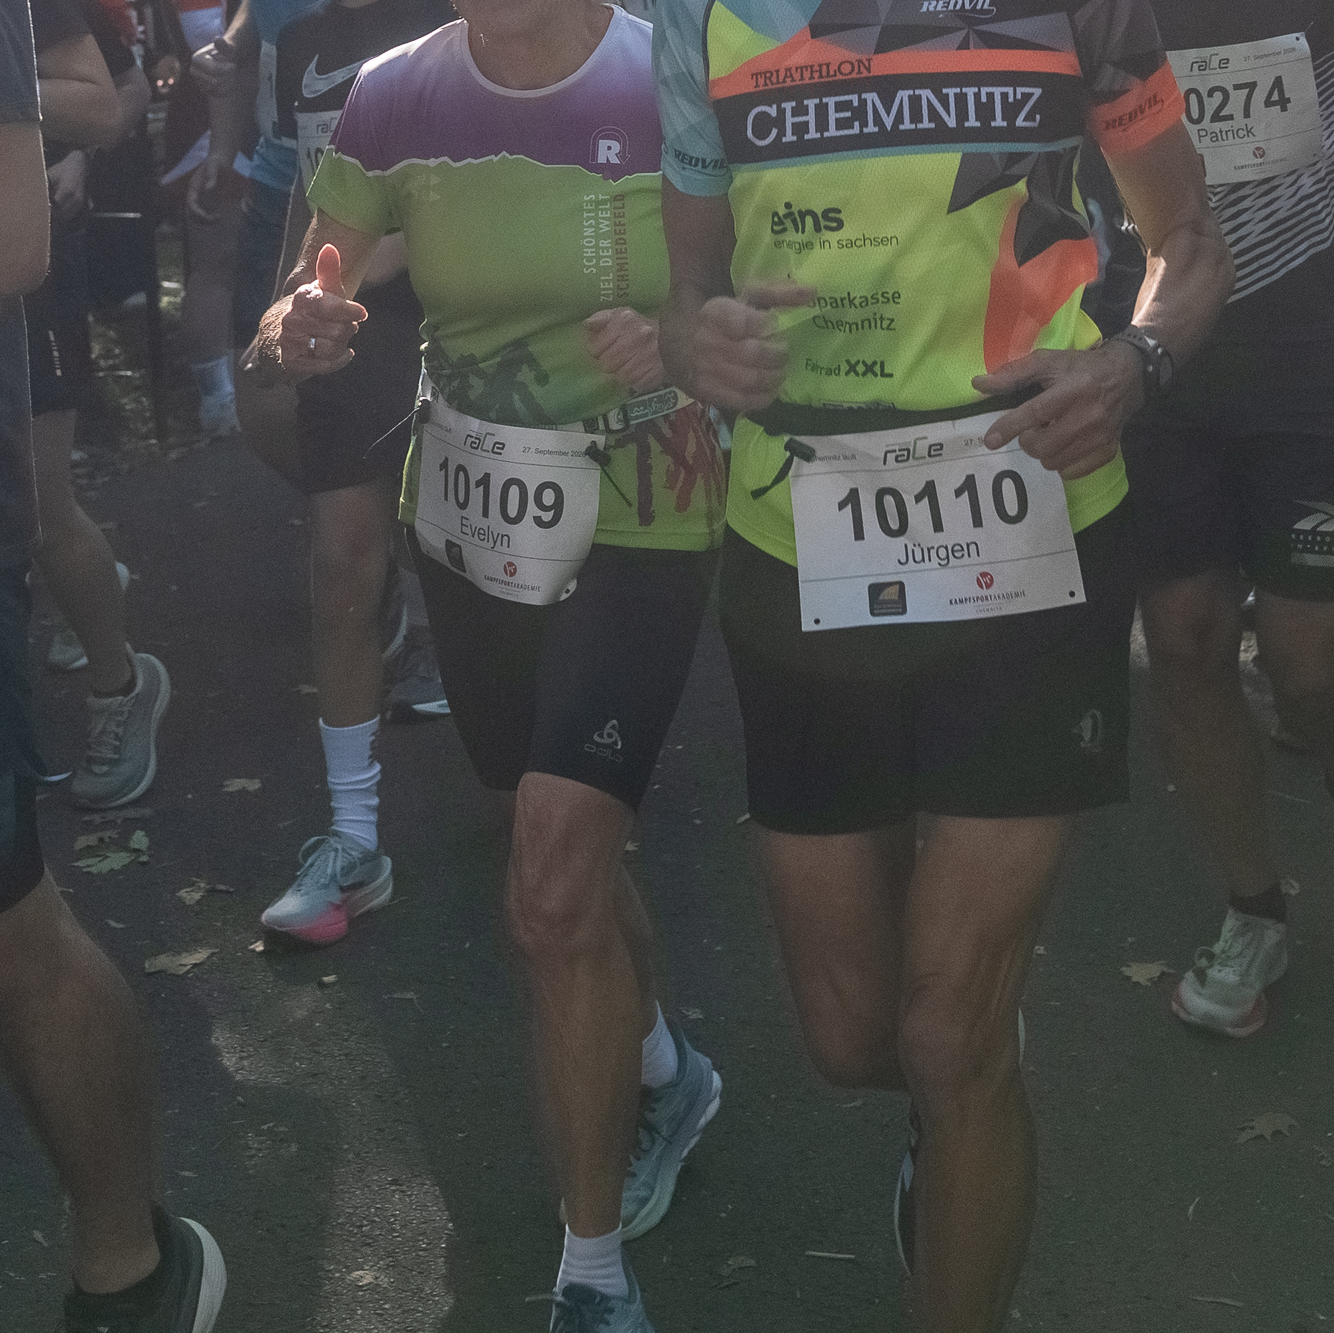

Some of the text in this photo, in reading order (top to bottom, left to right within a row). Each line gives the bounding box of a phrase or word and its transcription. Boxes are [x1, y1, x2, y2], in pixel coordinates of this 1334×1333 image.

[751, 57, 873, 89] TRIATHLON
[746, 86, 1043, 147] CHEMNITZ
[1183, 75, 1291, 126] 0274
[1196, 123, 1256, 144] Patrick
[597, 138, 621, 164] R
[581, 194, 597, 275] SCHÖNSTES
[770, 201, 845, 235] eins
[598, 193, 614, 302] ZIEL DER WELT
[612, 193, 630, 299] SCHMIEDEFELD
[818, 236, 832, 250] in
[836, 233, 900, 250] sachsen
[811, 313, 896, 334] Chemnitz
[844, 358, 894, 378] XXL
[521, 446, 534, 455] 27.
[535, 447, 570, 458] September
[438, 455, 565, 530] 10109
[837, 468, 1029, 542] 10110
[460, 515, 511, 550] Evelyn
[896, 539, 981, 568] Jürgen
[948, 589, 1027, 607] KAMPFSPORTAKADEMIE
